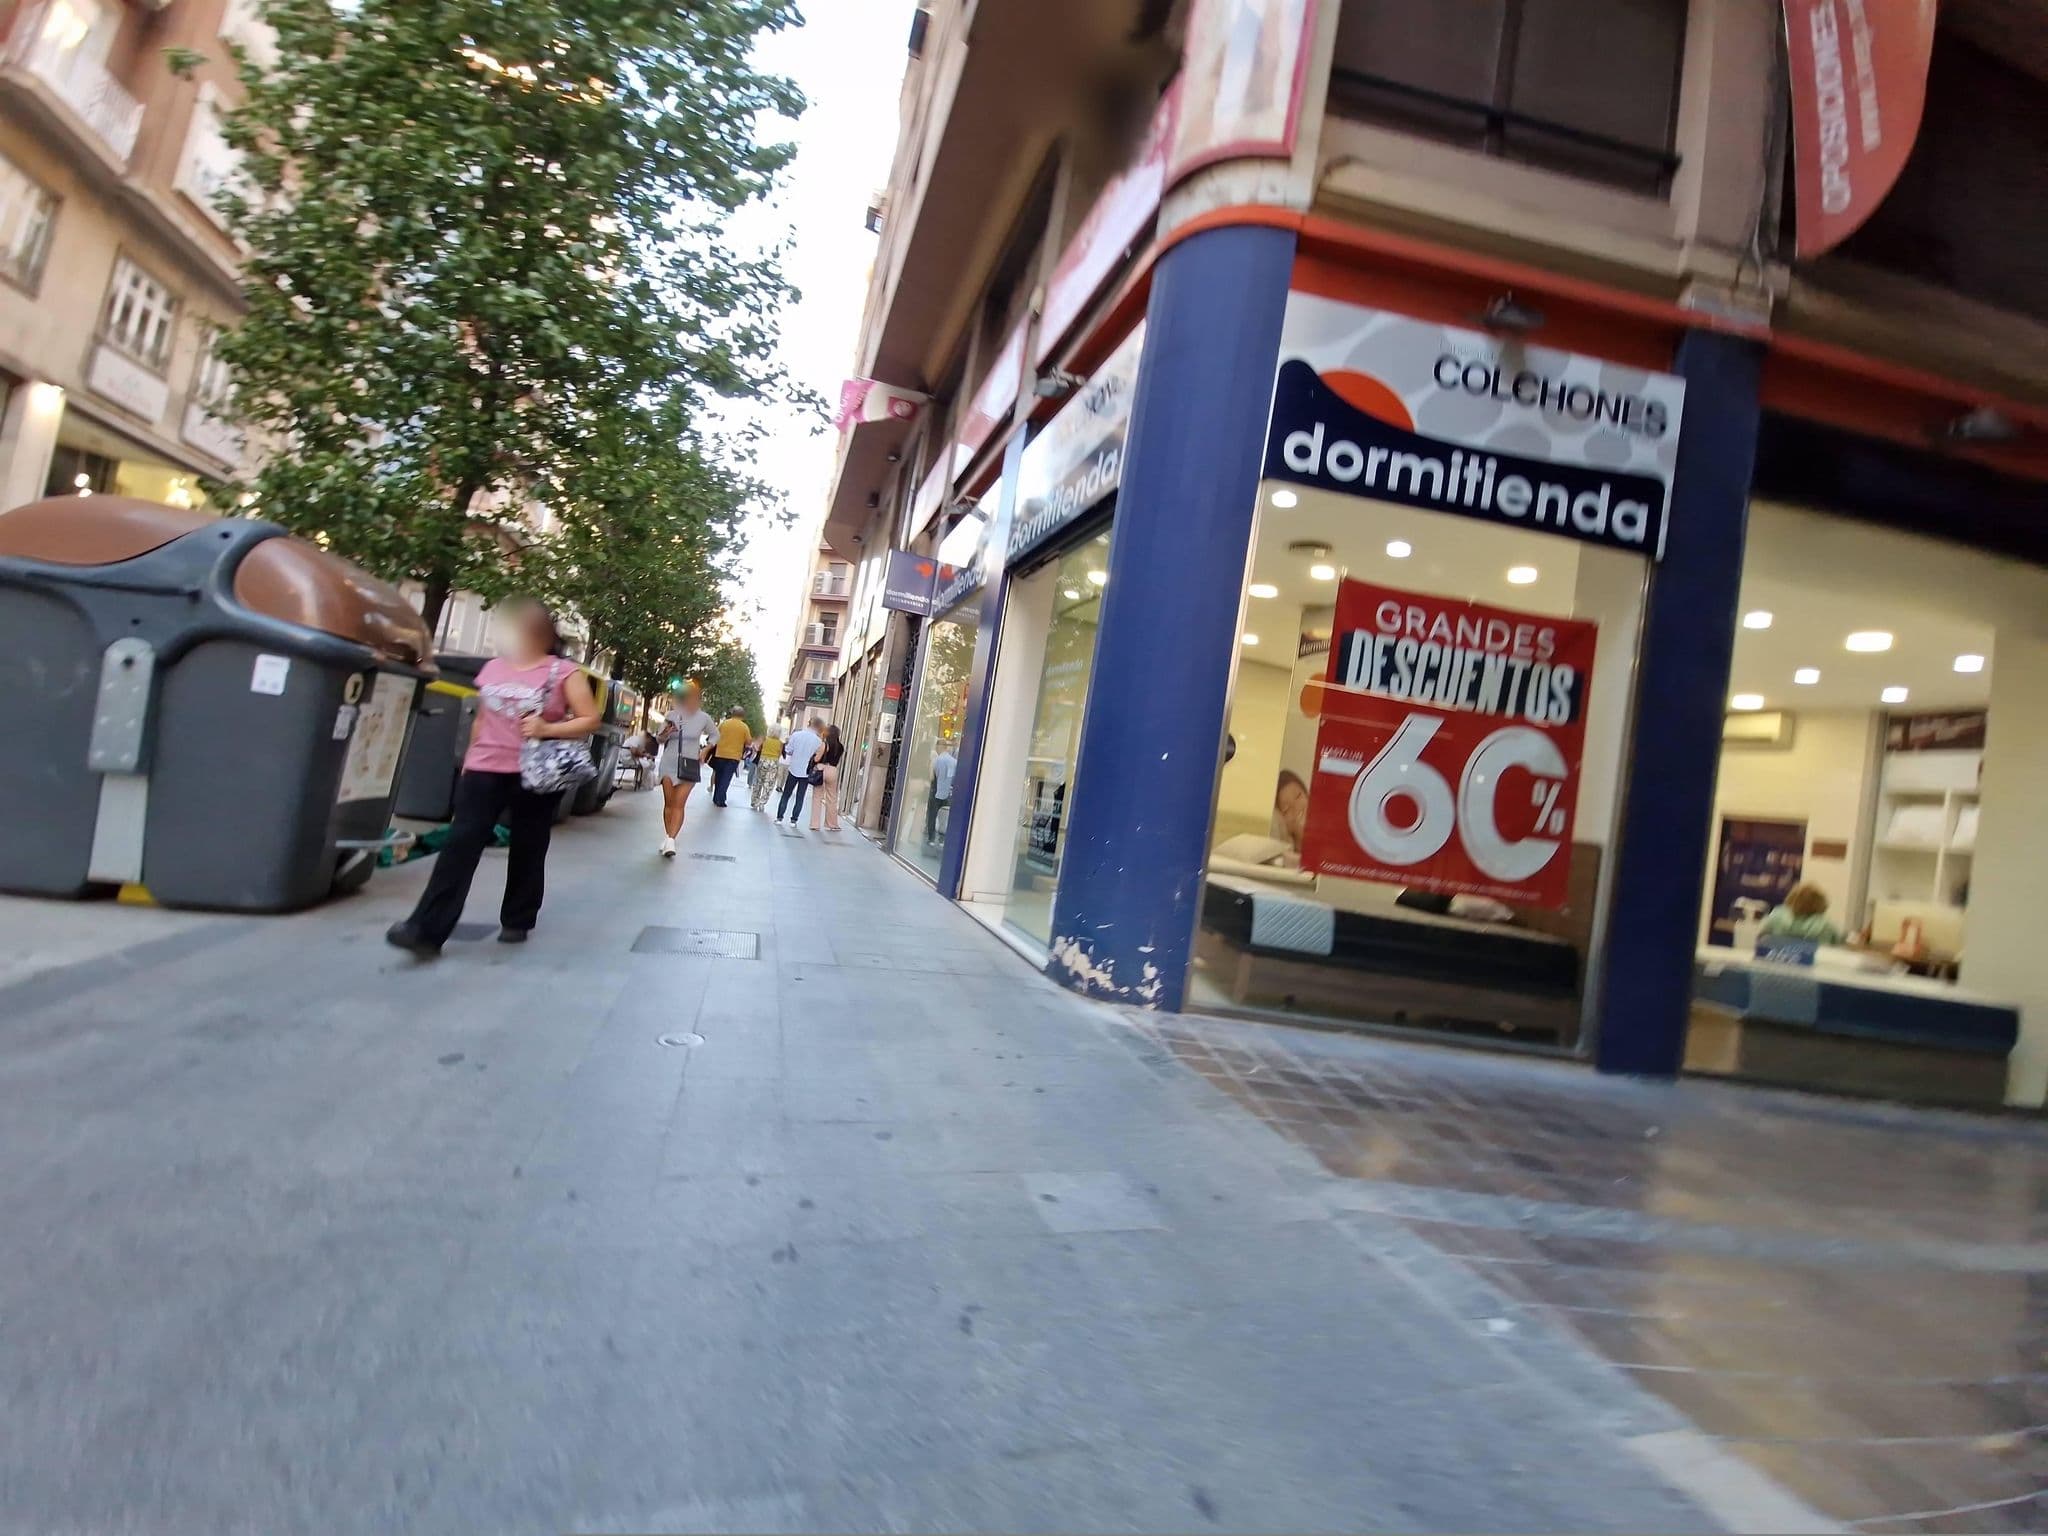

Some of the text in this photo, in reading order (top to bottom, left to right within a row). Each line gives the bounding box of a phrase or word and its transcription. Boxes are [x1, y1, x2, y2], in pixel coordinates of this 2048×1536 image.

[1433, 353, 1668, 439] COLCHONES
[1007, 447, 1119, 554] dormitienda
[1283, 421, 1650, 544] dormitienda
[1345, 627, 1576, 727] DESCUENTOS
[1375, 599, 1557, 661] GRANDES
